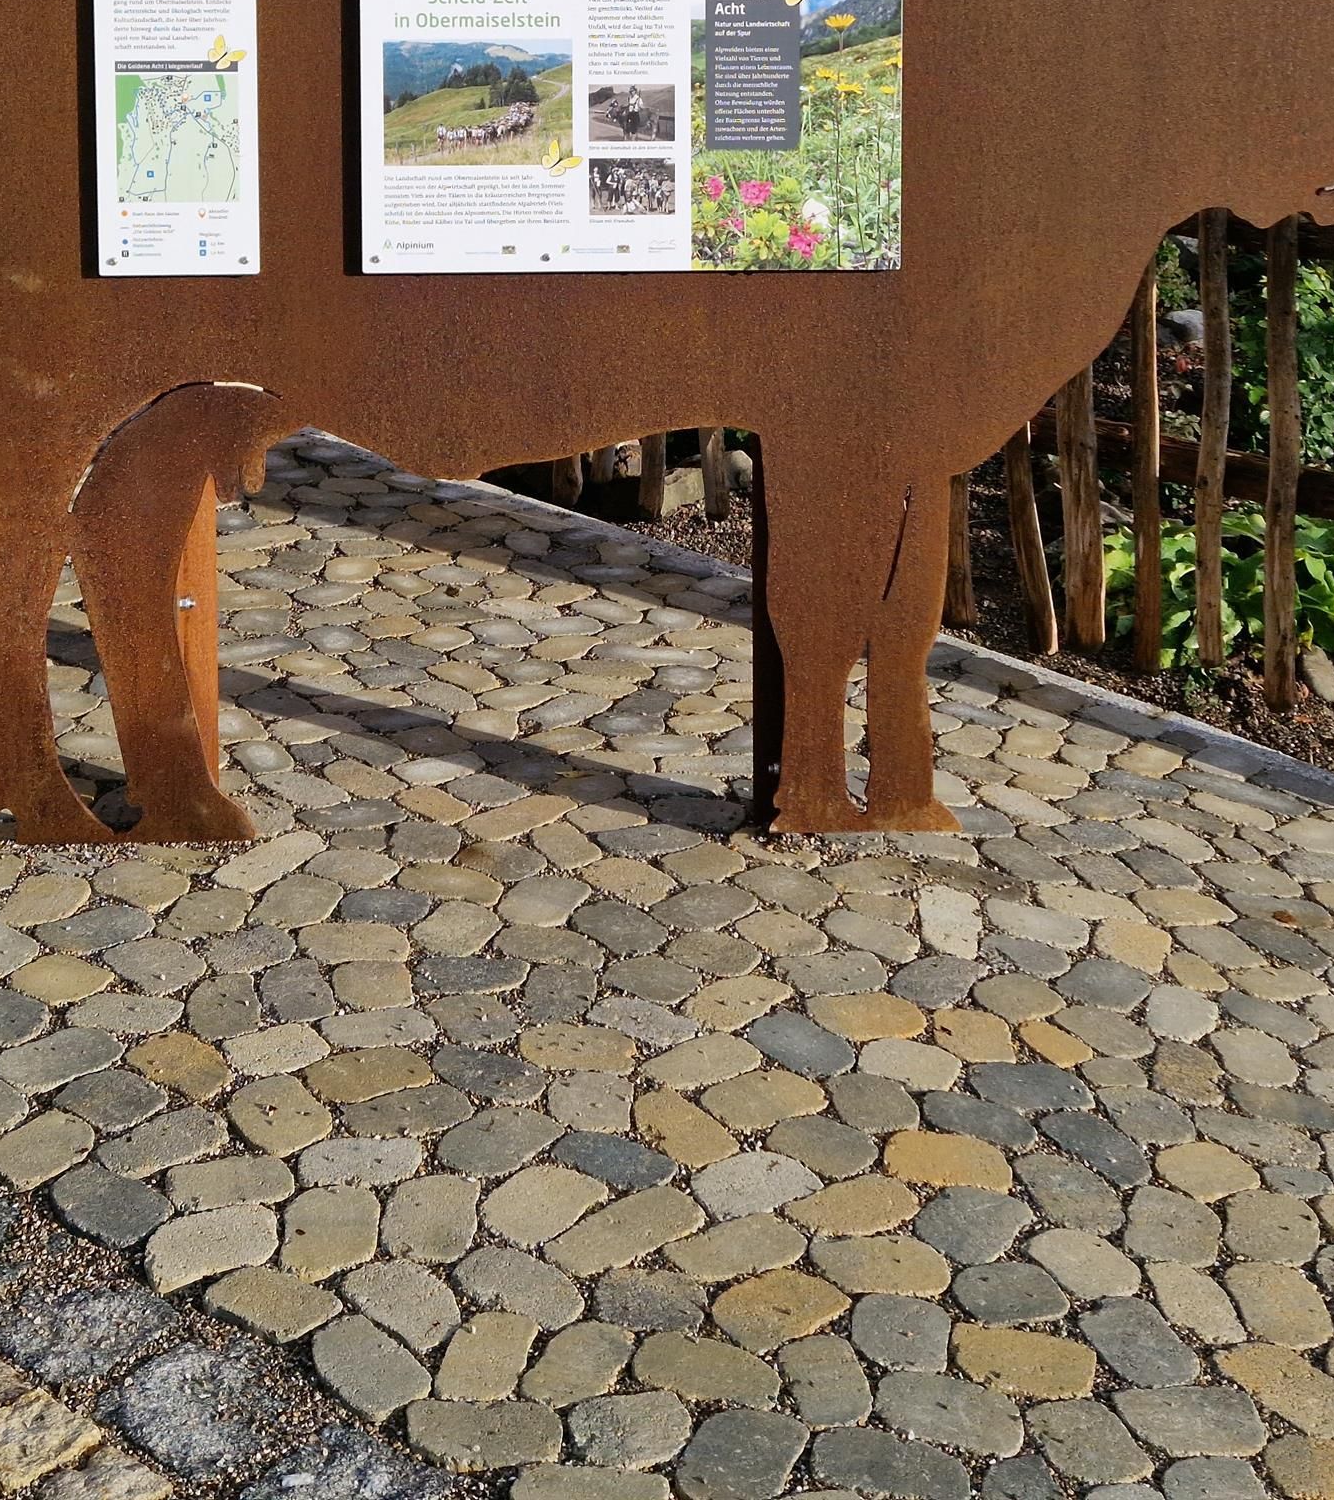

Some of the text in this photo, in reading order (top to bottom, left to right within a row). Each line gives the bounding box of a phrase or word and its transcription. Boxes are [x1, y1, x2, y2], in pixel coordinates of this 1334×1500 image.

[715, 2, 745, 15] Acht
[394, 12, 560, 28] in Obermaiselstein
[396, 242, 434, 250] Alpinium
